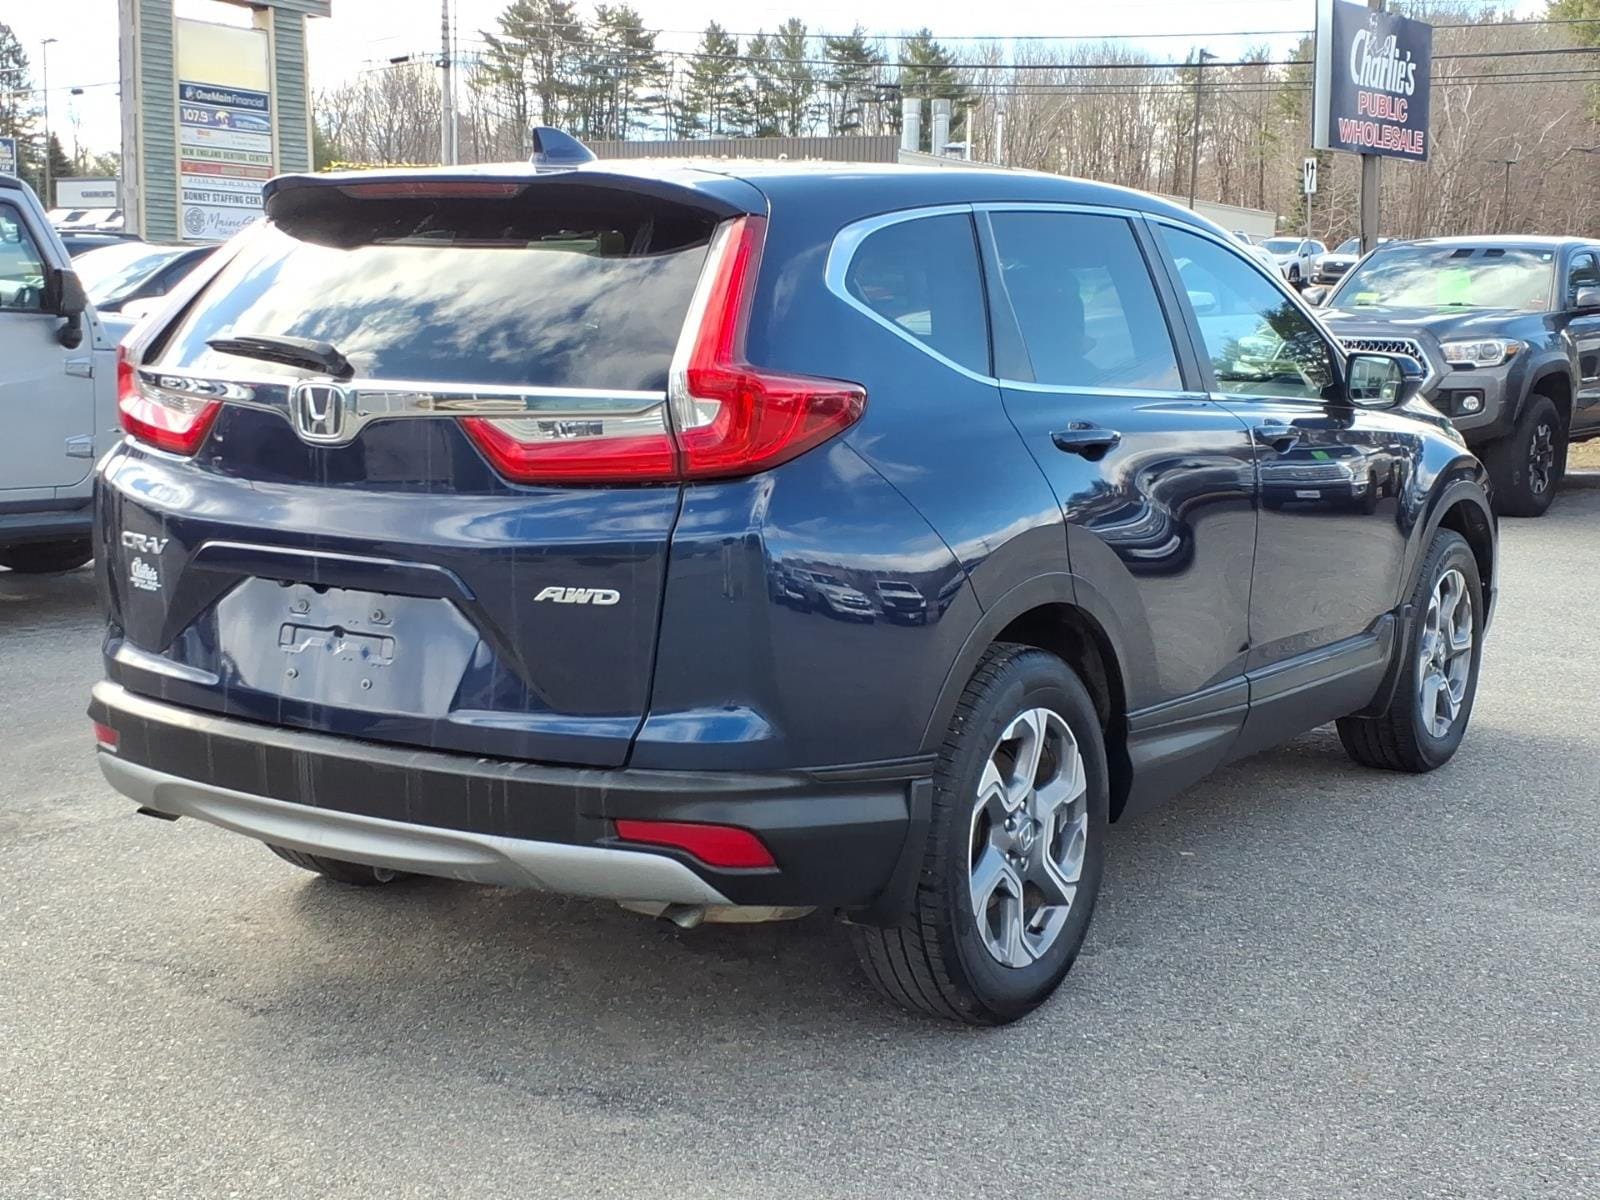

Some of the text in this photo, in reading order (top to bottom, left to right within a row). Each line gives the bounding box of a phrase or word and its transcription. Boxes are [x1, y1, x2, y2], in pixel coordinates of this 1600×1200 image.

[1350, 29, 1417, 96] Charlie's
[1358, 91, 1408, 123] PUBLIC
[1338, 117, 1424, 154] WHOLESALE
[182, 148, 195, 156] NEW
[196, 148, 221, 159] ENGLAND
[183, 191, 210, 203] BONNEY
[212, 193, 244, 205] STAFFING
[121, 530, 169, 554] CR-V
[533, 586, 620, 605] AWD
